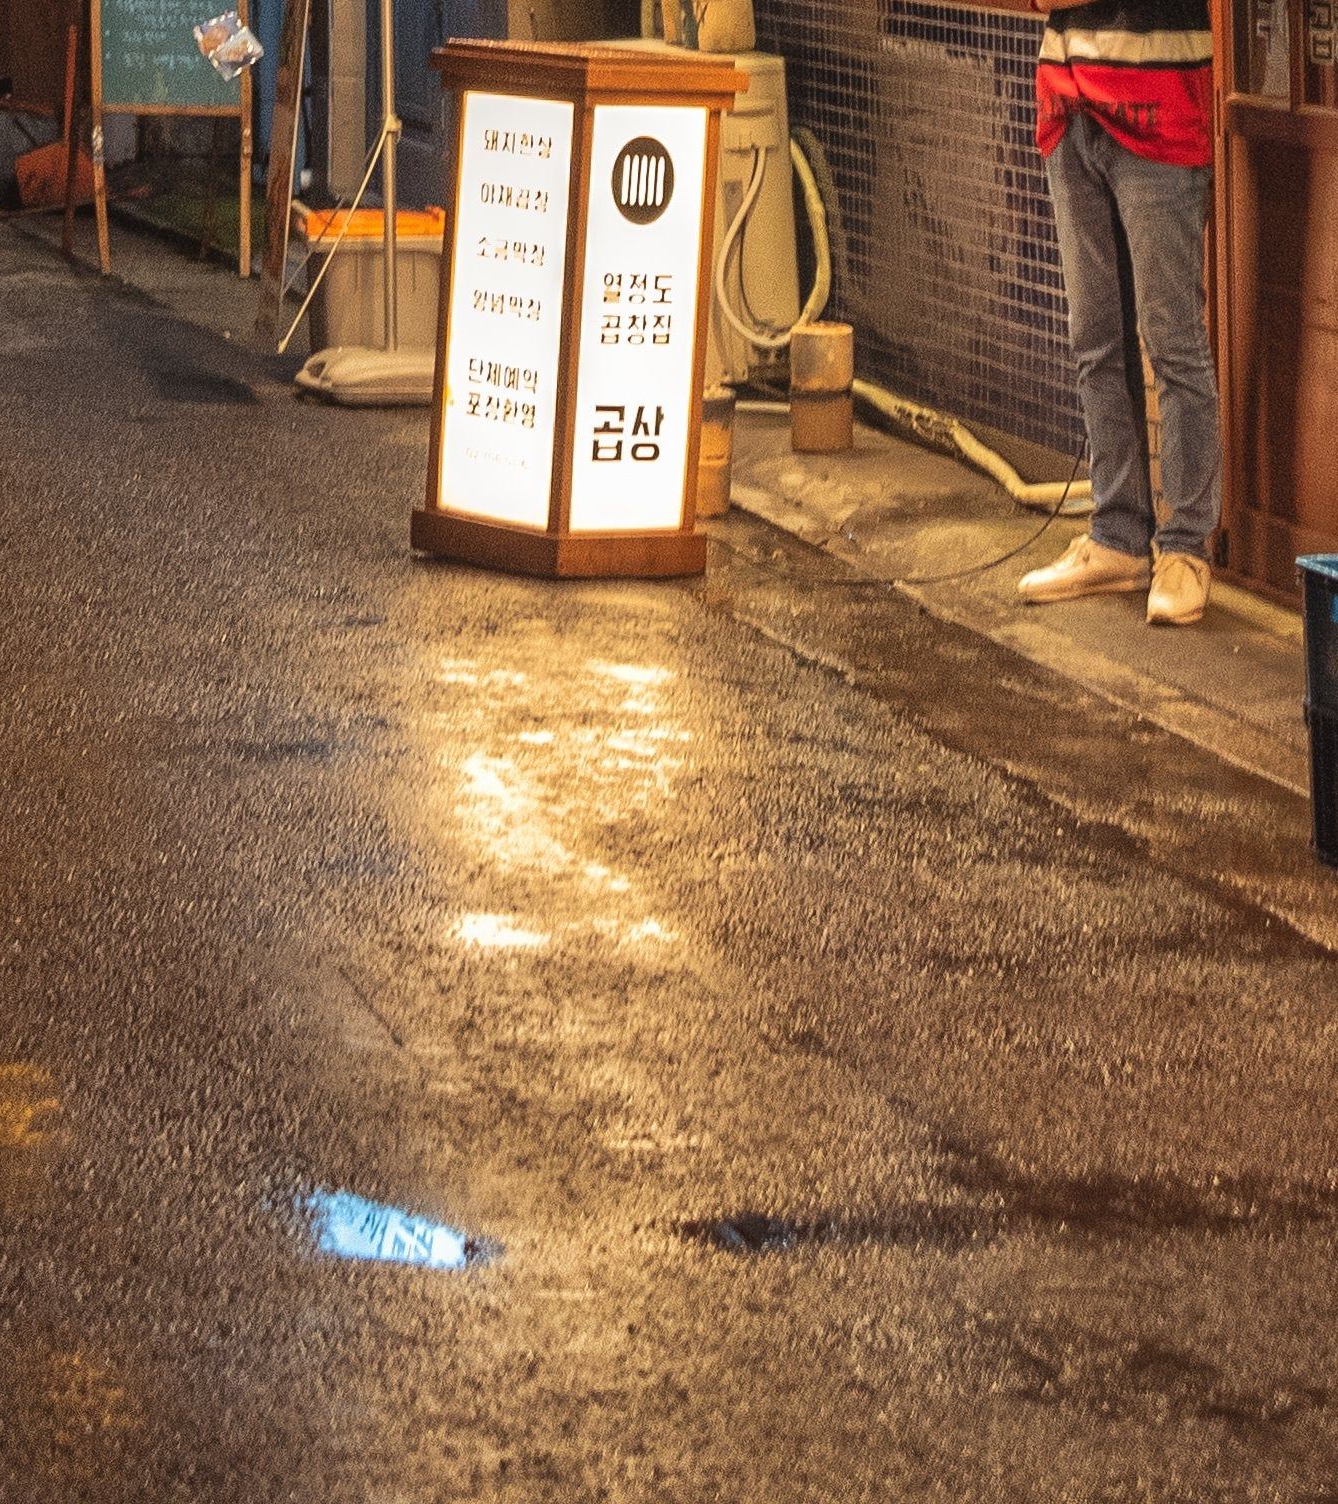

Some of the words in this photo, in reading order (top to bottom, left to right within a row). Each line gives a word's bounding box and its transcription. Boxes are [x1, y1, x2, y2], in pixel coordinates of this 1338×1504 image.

[603, 272, 674, 305] 열정도
[600, 314, 673, 346] 곱창집
[468, 356, 539, 394] 단체예약
[591, 404, 665, 463] 곱상
